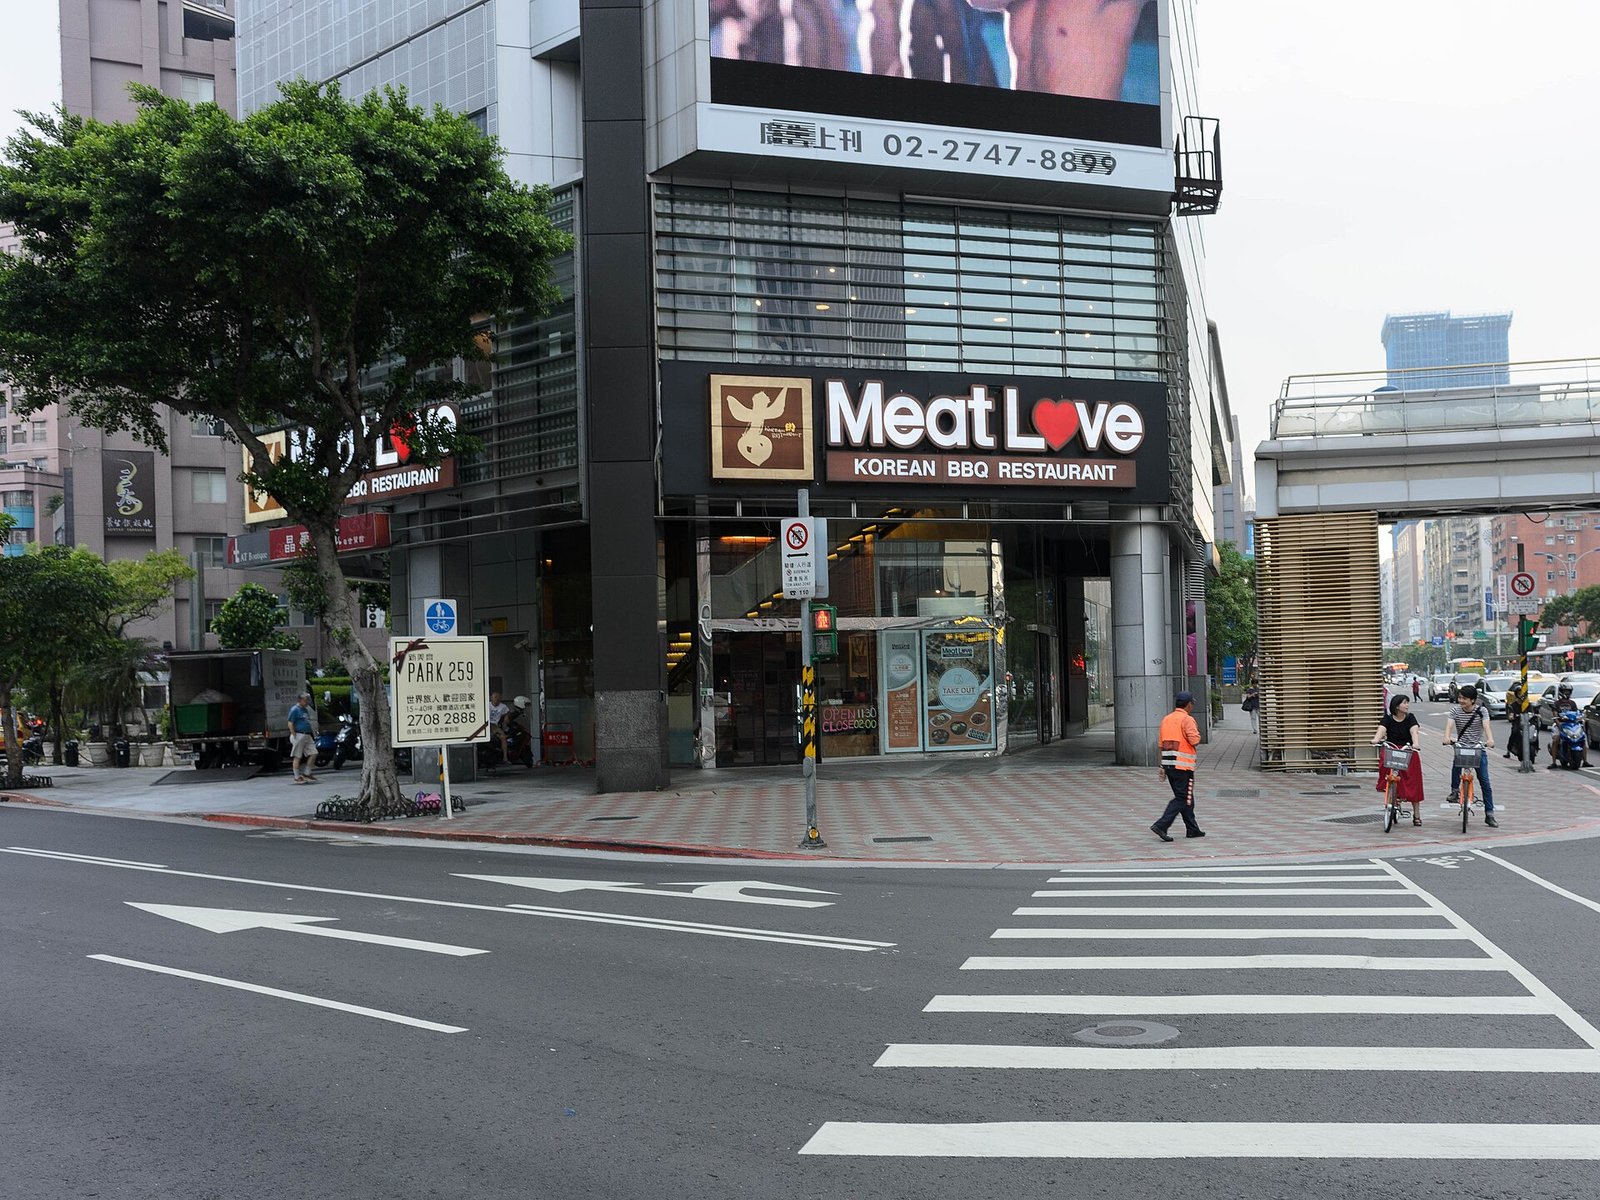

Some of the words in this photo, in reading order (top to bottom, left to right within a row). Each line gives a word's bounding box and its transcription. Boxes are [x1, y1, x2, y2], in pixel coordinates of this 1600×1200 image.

[826, 380, 995, 449] Meat
[853, 458, 936, 477] KOREAN
[947, 460, 989, 479] BBQ
[998, 461, 1117, 481] RESTAURANT
[371, 465, 441, 494] RESTAURANT
[408, 661, 443, 682] PARK
[448, 661, 473, 682] 259
[406, 694, 440, 704] 世界旅人
[443, 693, 475, 703] 歡迎回家
[407, 713, 440, 727] 2708
[443, 711, 476, 724] 2888
[823, 708, 856, 720] OPEN
[822, 720, 854, 732] CLOSE
